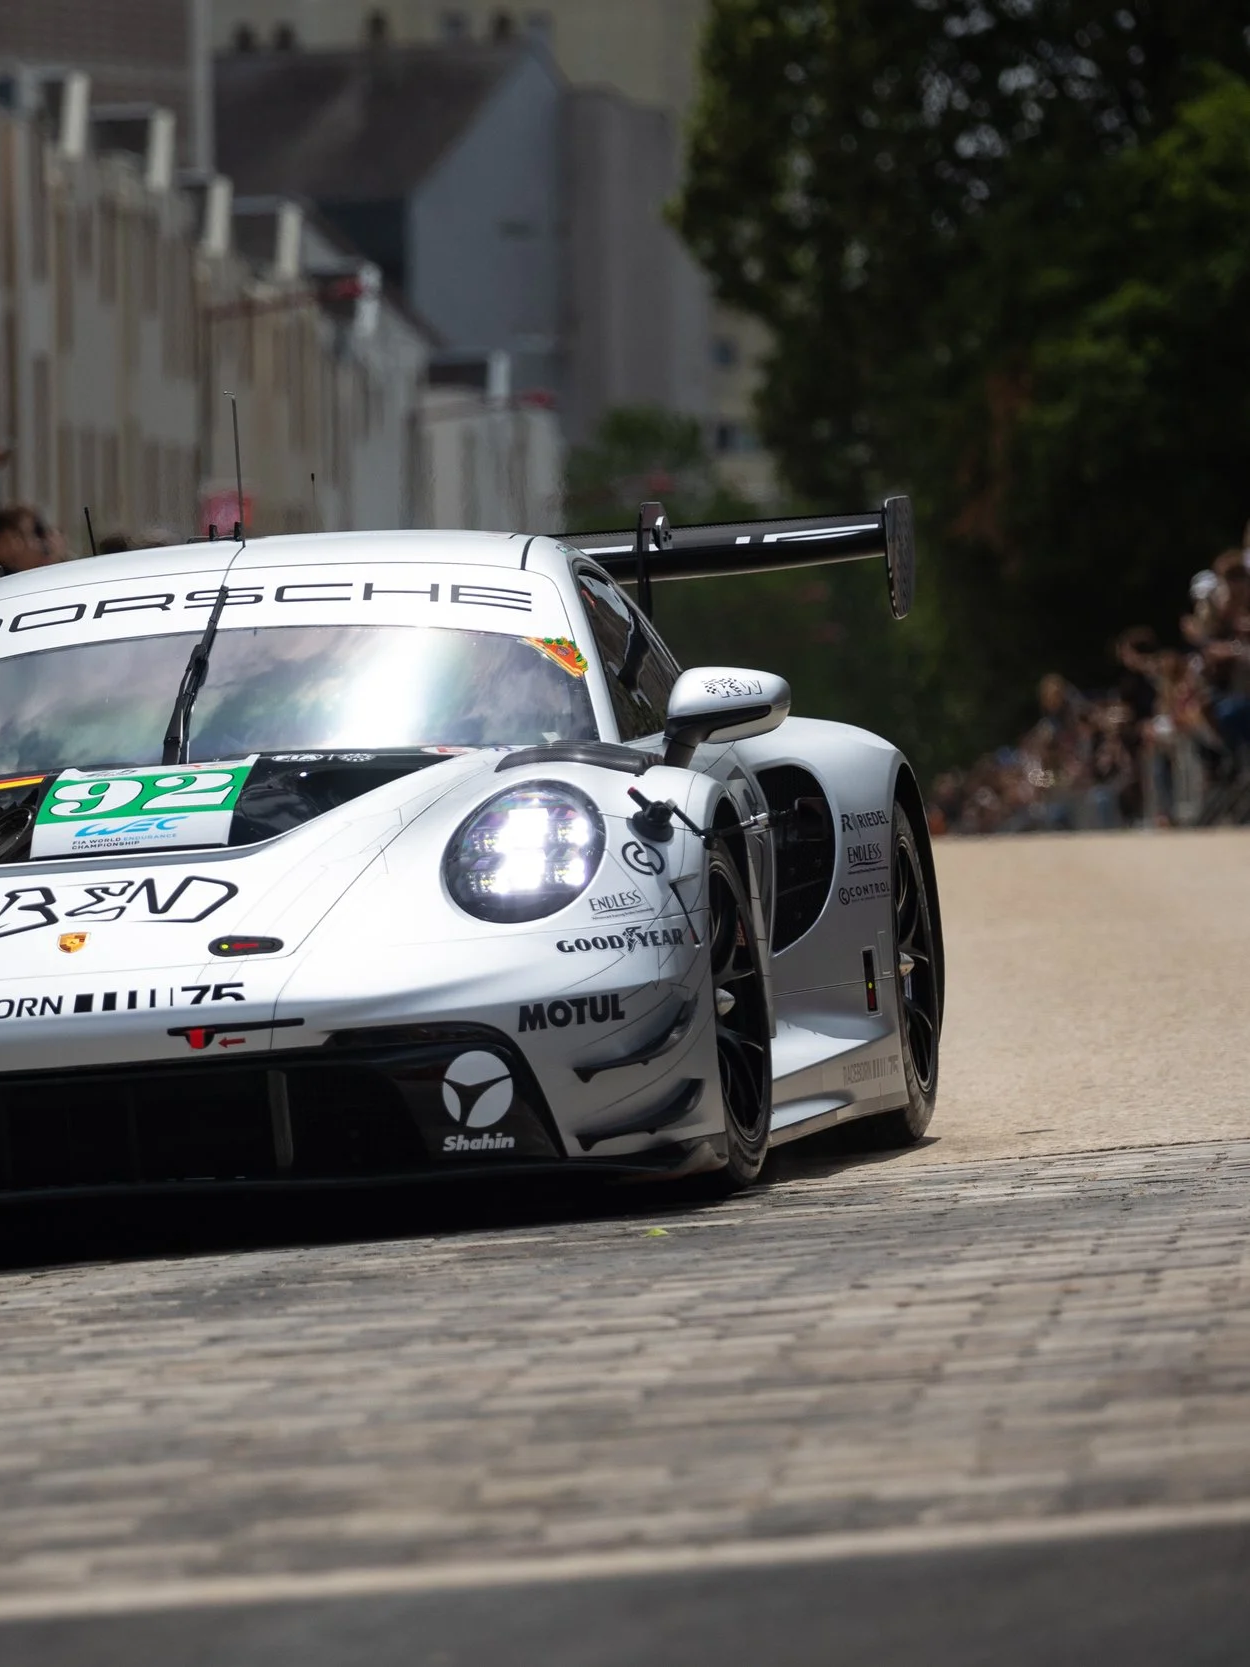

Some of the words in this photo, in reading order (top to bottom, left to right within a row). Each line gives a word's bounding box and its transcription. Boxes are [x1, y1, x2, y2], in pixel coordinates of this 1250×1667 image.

[50, 773, 236, 816] 92
[75, 816, 189, 837] WEC
[857, 810, 889, 829] RIEDEL
[71, 840, 140, 850] CHAMPIONSHIP
[90, 837, 121, 845] WORLD
[123, 833, 178, 841] ENDURANCE
[847, 842, 882, 863] ENDLESS
[849, 881, 890, 897] CONTROL
[588, 889, 642, 911] ENDLESS
[181, 982, 246, 1006] 75
[518, 993, 625, 1033] MOTUL
[443, 1132, 515, 1152] Shahin
